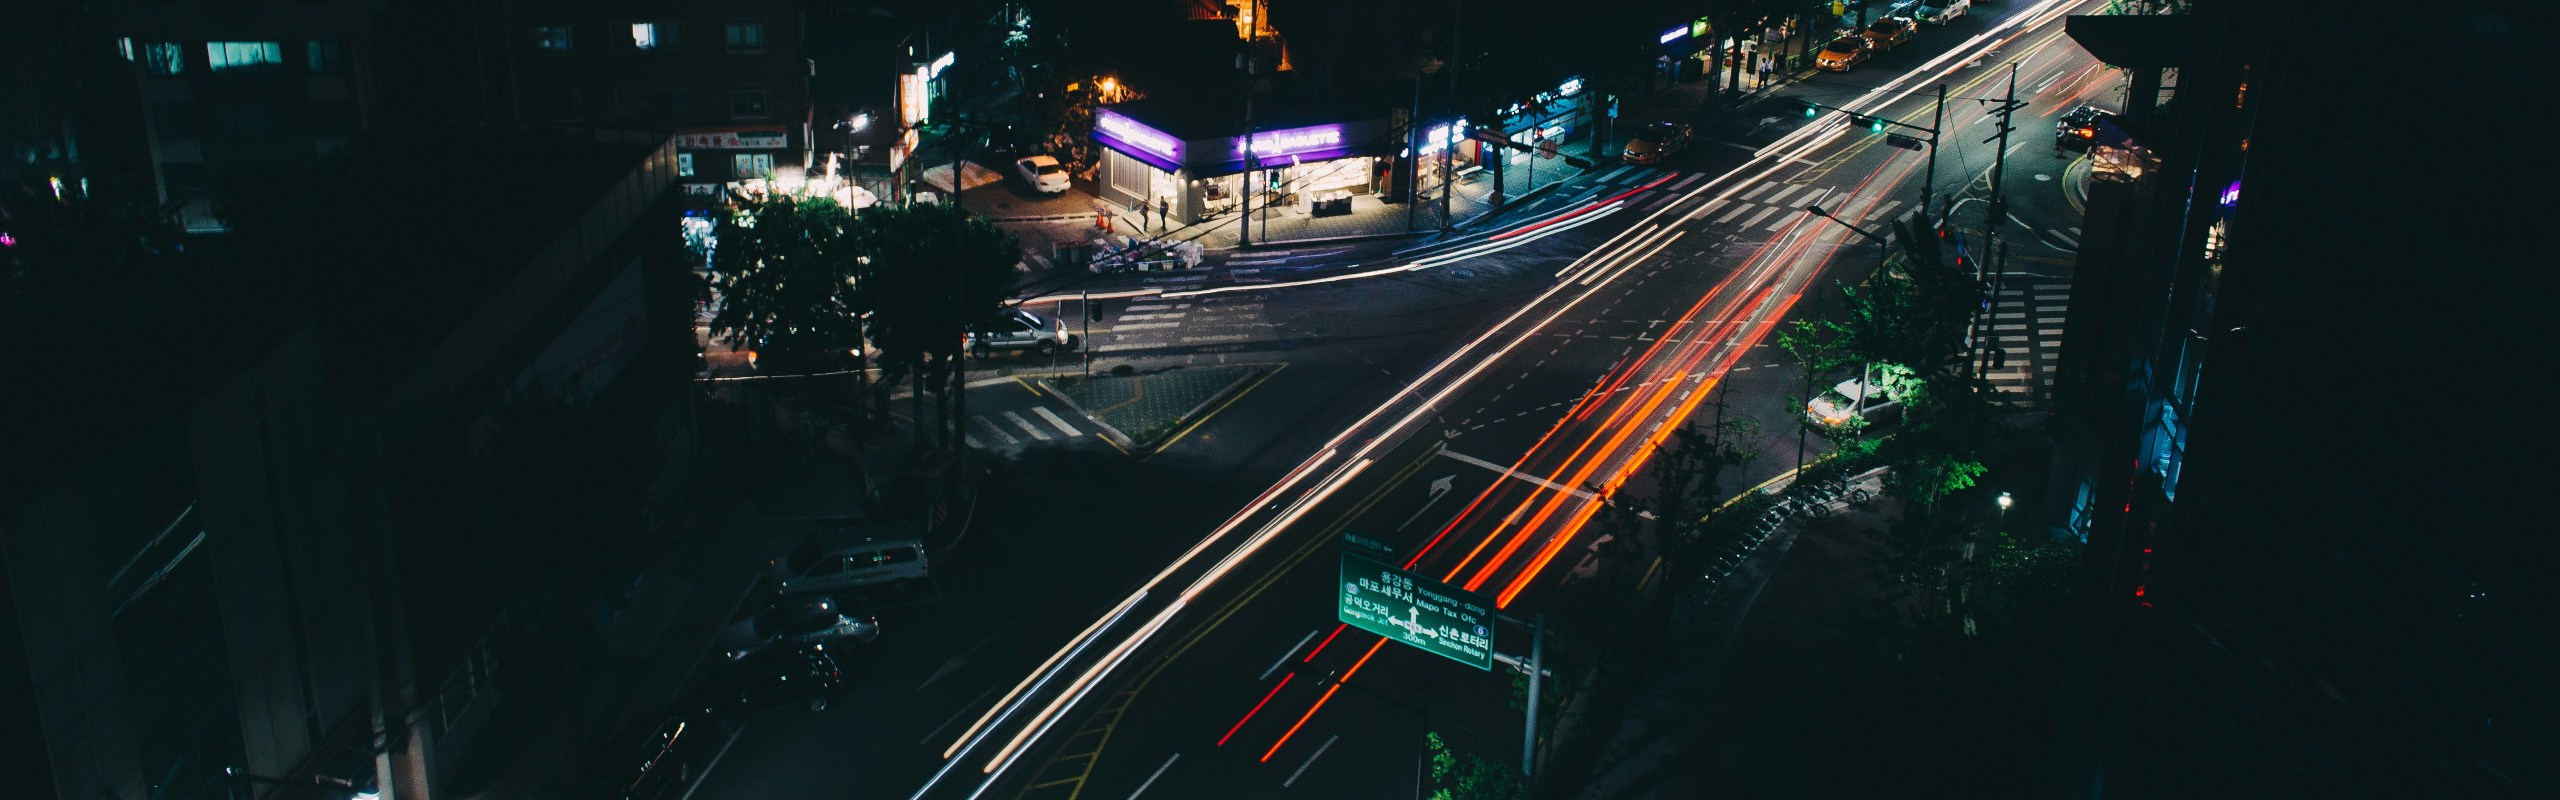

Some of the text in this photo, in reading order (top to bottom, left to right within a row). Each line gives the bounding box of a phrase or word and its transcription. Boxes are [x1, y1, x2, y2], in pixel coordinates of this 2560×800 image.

[1359, 577, 1413, 604] 마포세무서
[1381, 571, 1413, 590] 용강동
[1344, 593, 1389, 618] 공덕오거리
[1416, 599, 1440, 614] Mapo
[1442, 607, 1457, 619] Tax
[1403, 633, 1427, 647] 300m
[1438, 625, 1489, 650] 신촌로터리
[1477, 626, 1485, 635] 6
[1438, 637, 1486, 660] Sinchon Rotary
